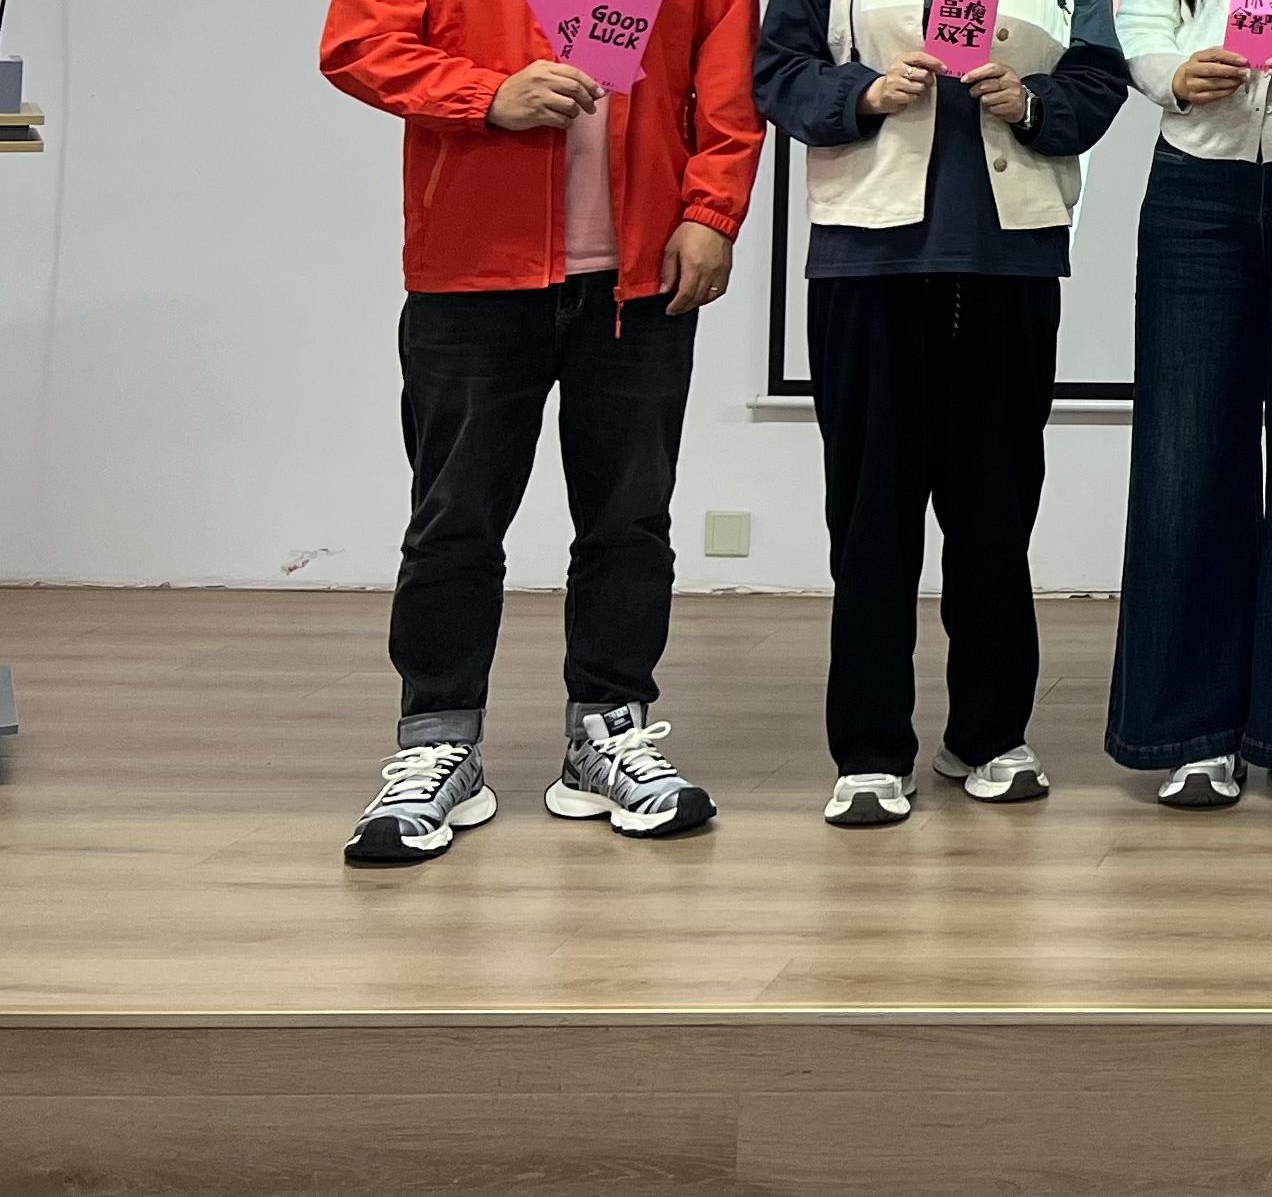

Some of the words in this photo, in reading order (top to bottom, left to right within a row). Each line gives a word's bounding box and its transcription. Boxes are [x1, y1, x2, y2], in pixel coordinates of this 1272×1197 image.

[591, 5, 649, 33] GOOD
[588, 22, 641, 50] LUCK
[934, 21, 987, 48] 双全
